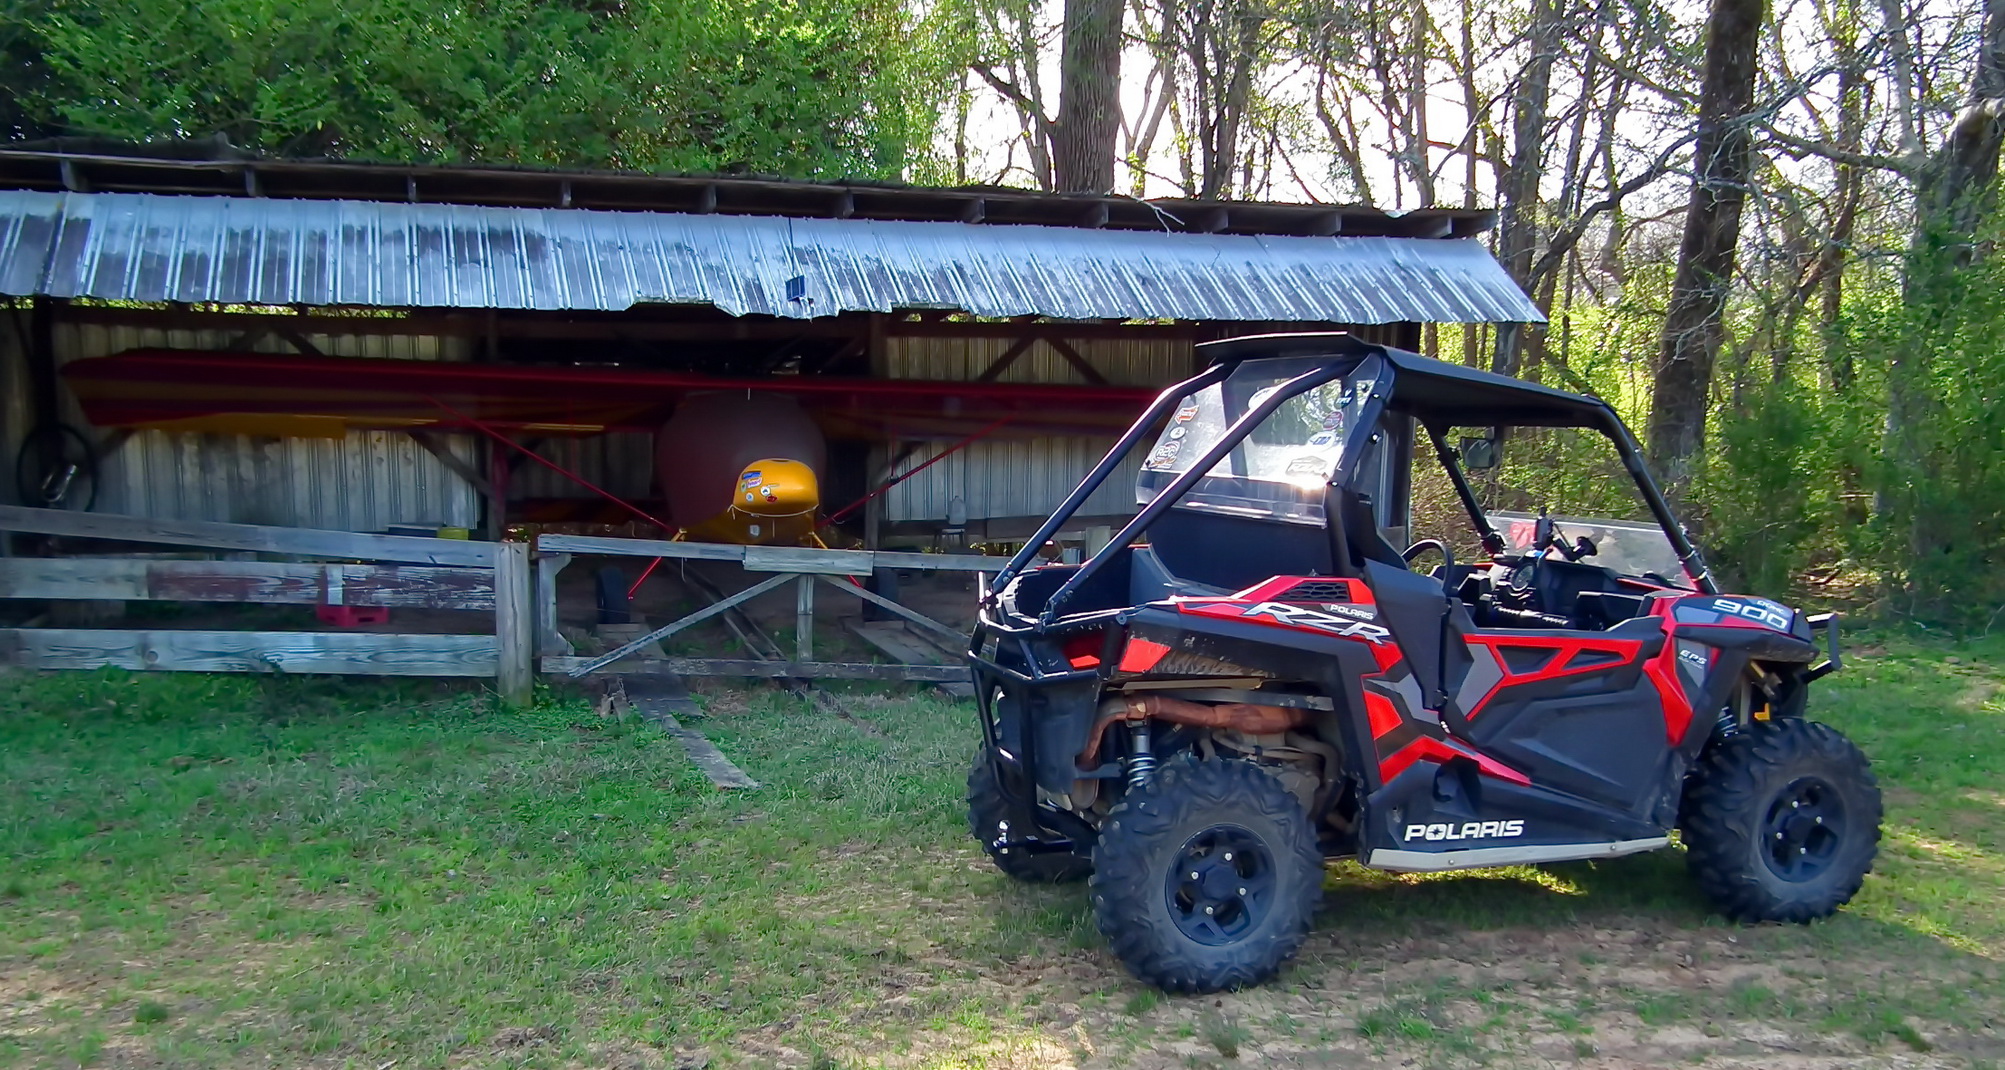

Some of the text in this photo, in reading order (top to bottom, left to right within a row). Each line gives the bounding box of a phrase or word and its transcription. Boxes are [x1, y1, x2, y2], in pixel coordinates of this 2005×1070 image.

[1242, 602, 1391, 644] RZR
[1329, 604, 1374, 620] POLARIS
[1712, 599, 1788, 629] 900
[1680, 649, 1707, 664] EPS
[1404, 820, 1525, 842] POLARIS
